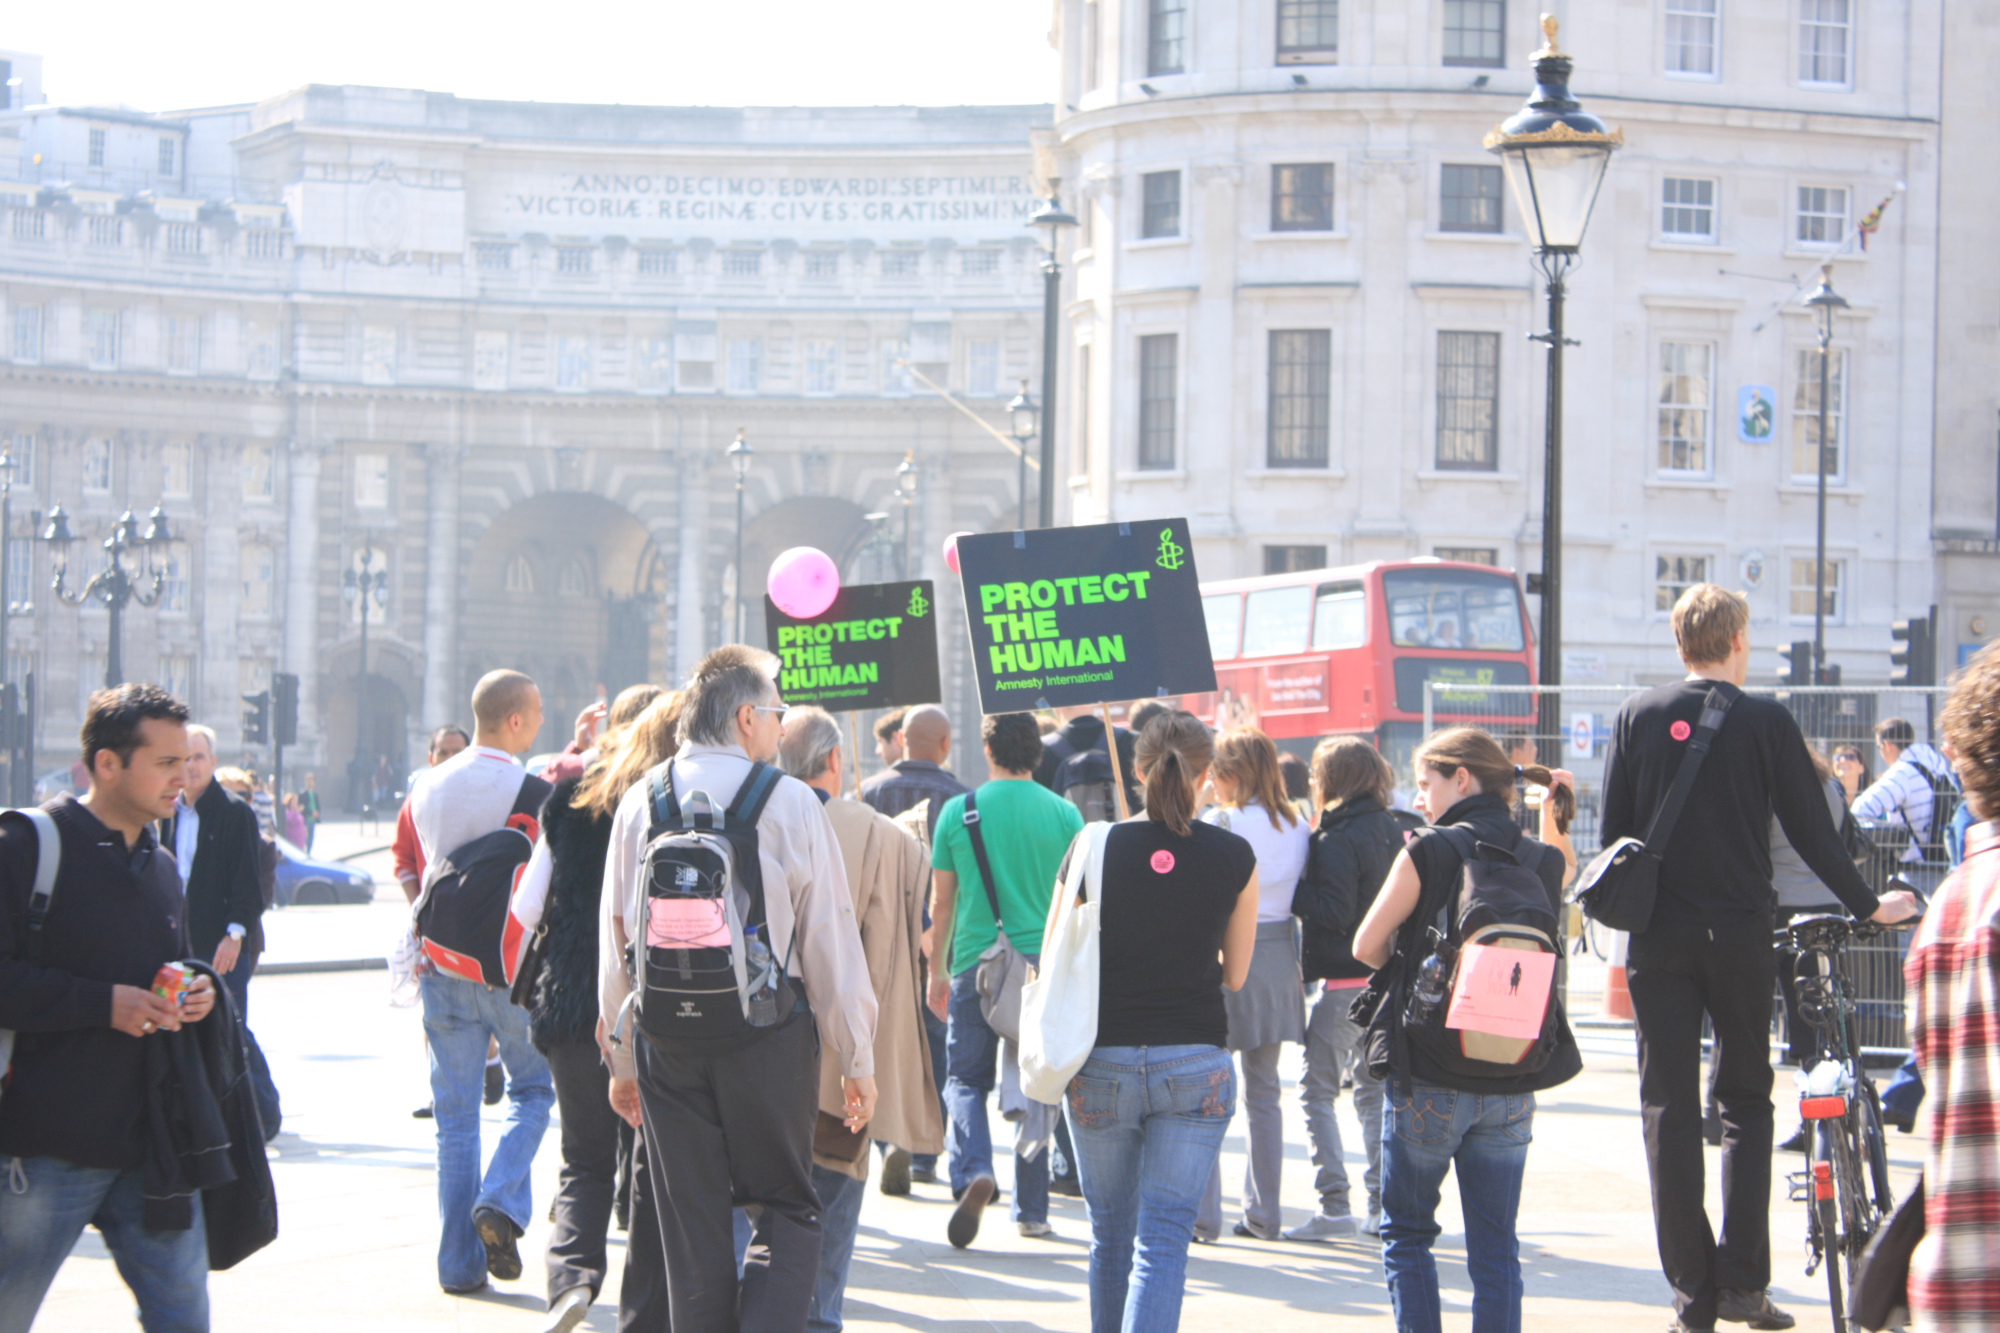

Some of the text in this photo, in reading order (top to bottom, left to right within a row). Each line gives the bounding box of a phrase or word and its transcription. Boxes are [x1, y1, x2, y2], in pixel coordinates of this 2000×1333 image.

[572, 175, 652, 194] ANNO
[665, 177, 765, 197] DECIMO
[778, 177, 887, 197] EDWARDI
[900, 177, 995, 197] SEPTIMI
[771, 202, 848, 221] CIVES
[862, 202, 999, 221] GRATISSIMI
[979, 570, 1151, 613] PROTECT
[777, 617, 903, 648] PROTECT
[983, 610, 1060, 643] THE
[779, 644, 833, 668] THE
[988, 634, 1127, 674] HUMAN
[780, 662, 879, 690] HUMAN
[995, 669, 1114, 692] Amnesty International
[1477, 668, 1495, 687] 87
[782, 687, 868, 701] Amnesty International
